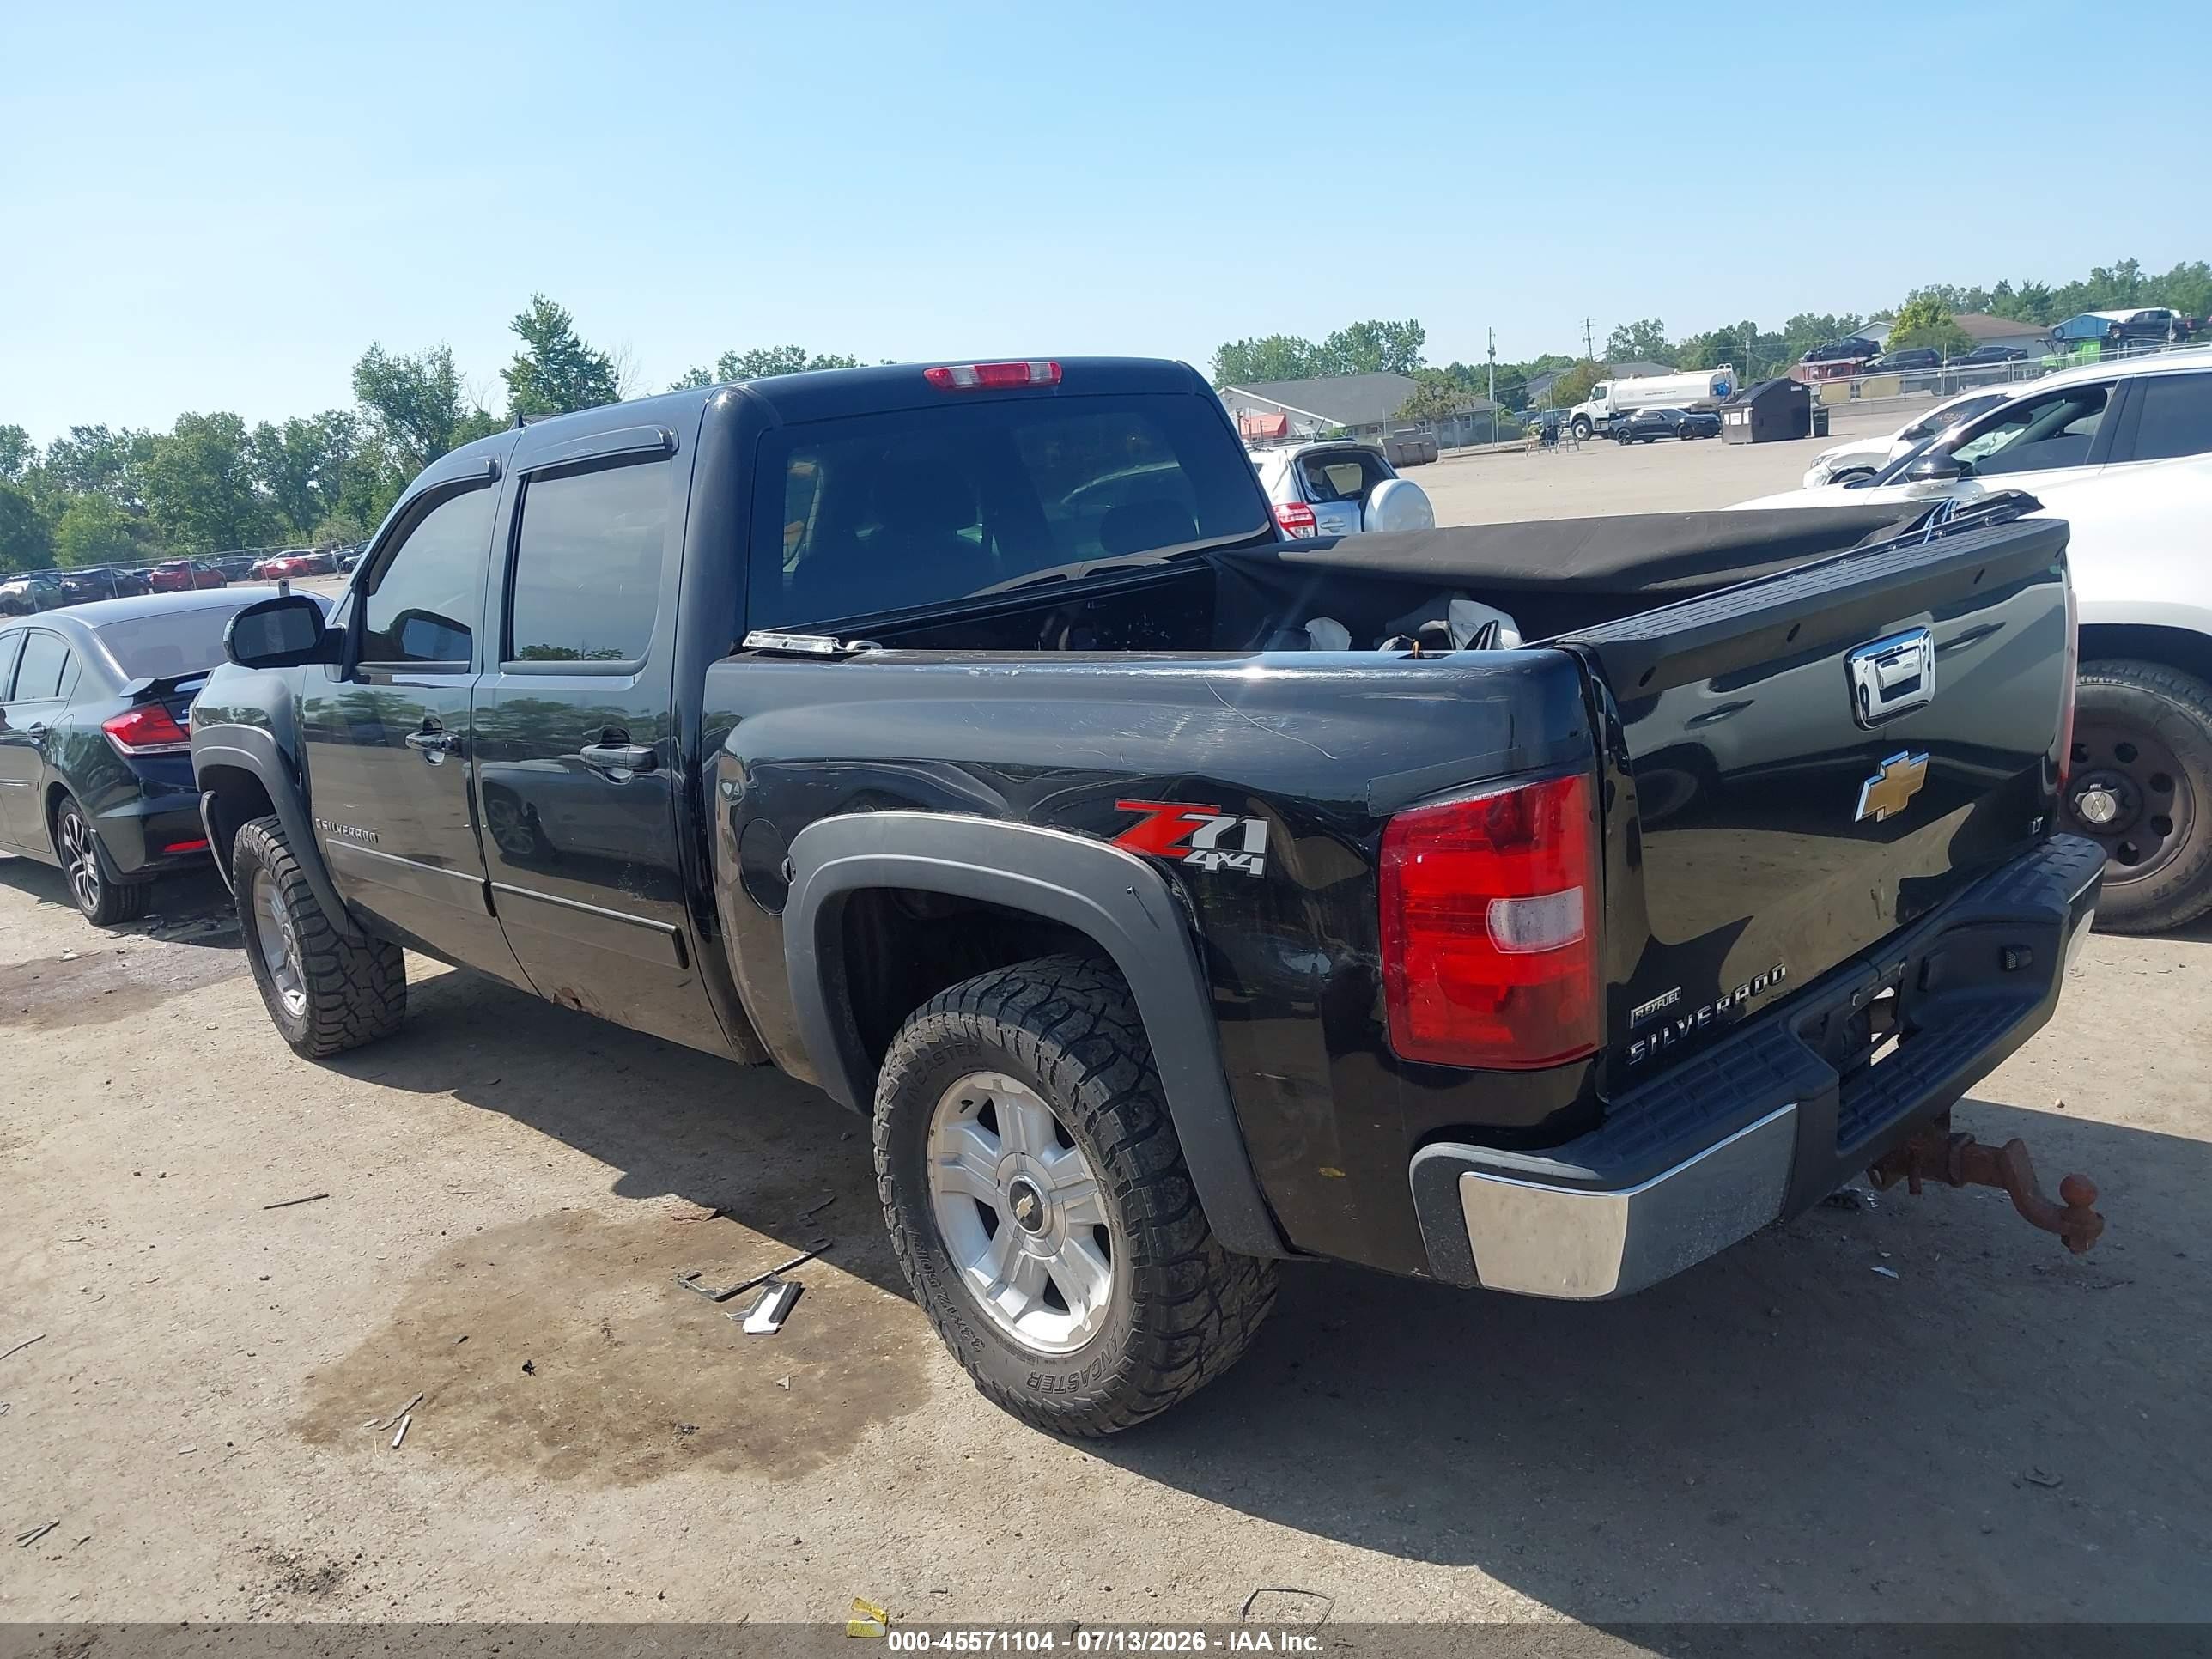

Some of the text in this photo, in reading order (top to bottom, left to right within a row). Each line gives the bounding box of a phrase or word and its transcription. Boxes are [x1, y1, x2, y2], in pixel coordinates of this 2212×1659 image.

[321, 819, 379, 844] SILVERADO
[1111, 798, 1270, 858] Z71
[1628, 963, 1787, 1066] SILVERADO
